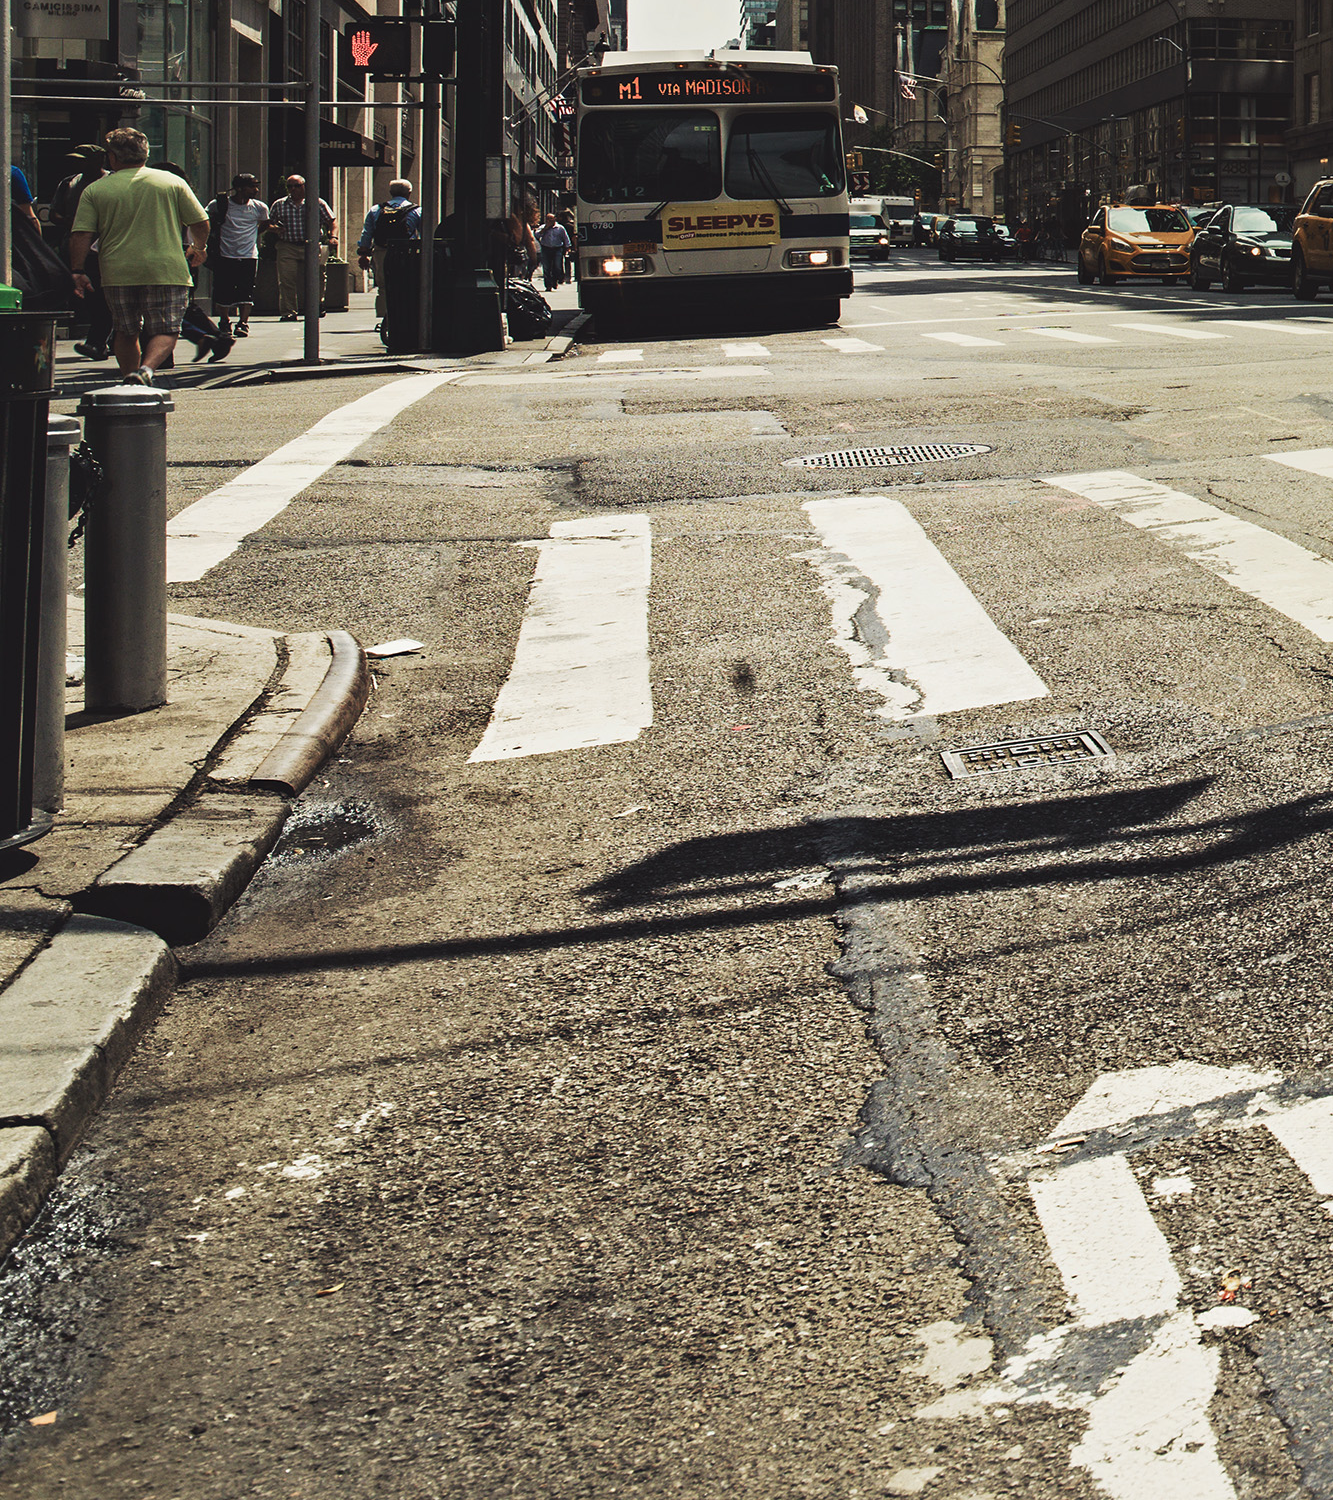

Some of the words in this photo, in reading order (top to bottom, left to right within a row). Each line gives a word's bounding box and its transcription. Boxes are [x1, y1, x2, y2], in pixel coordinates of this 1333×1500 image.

[23, 1, 101, 13] CAMICISSIMA
[618, 76, 643, 100] M1
[658, 83, 681, 96] VIA
[685, 79, 751, 96] MADISON
[320, 140, 356, 150] ellini
[1223, 162, 1248, 174] 488
[592, 222, 615, 230] 6780
[680, 232, 695, 240] Only
